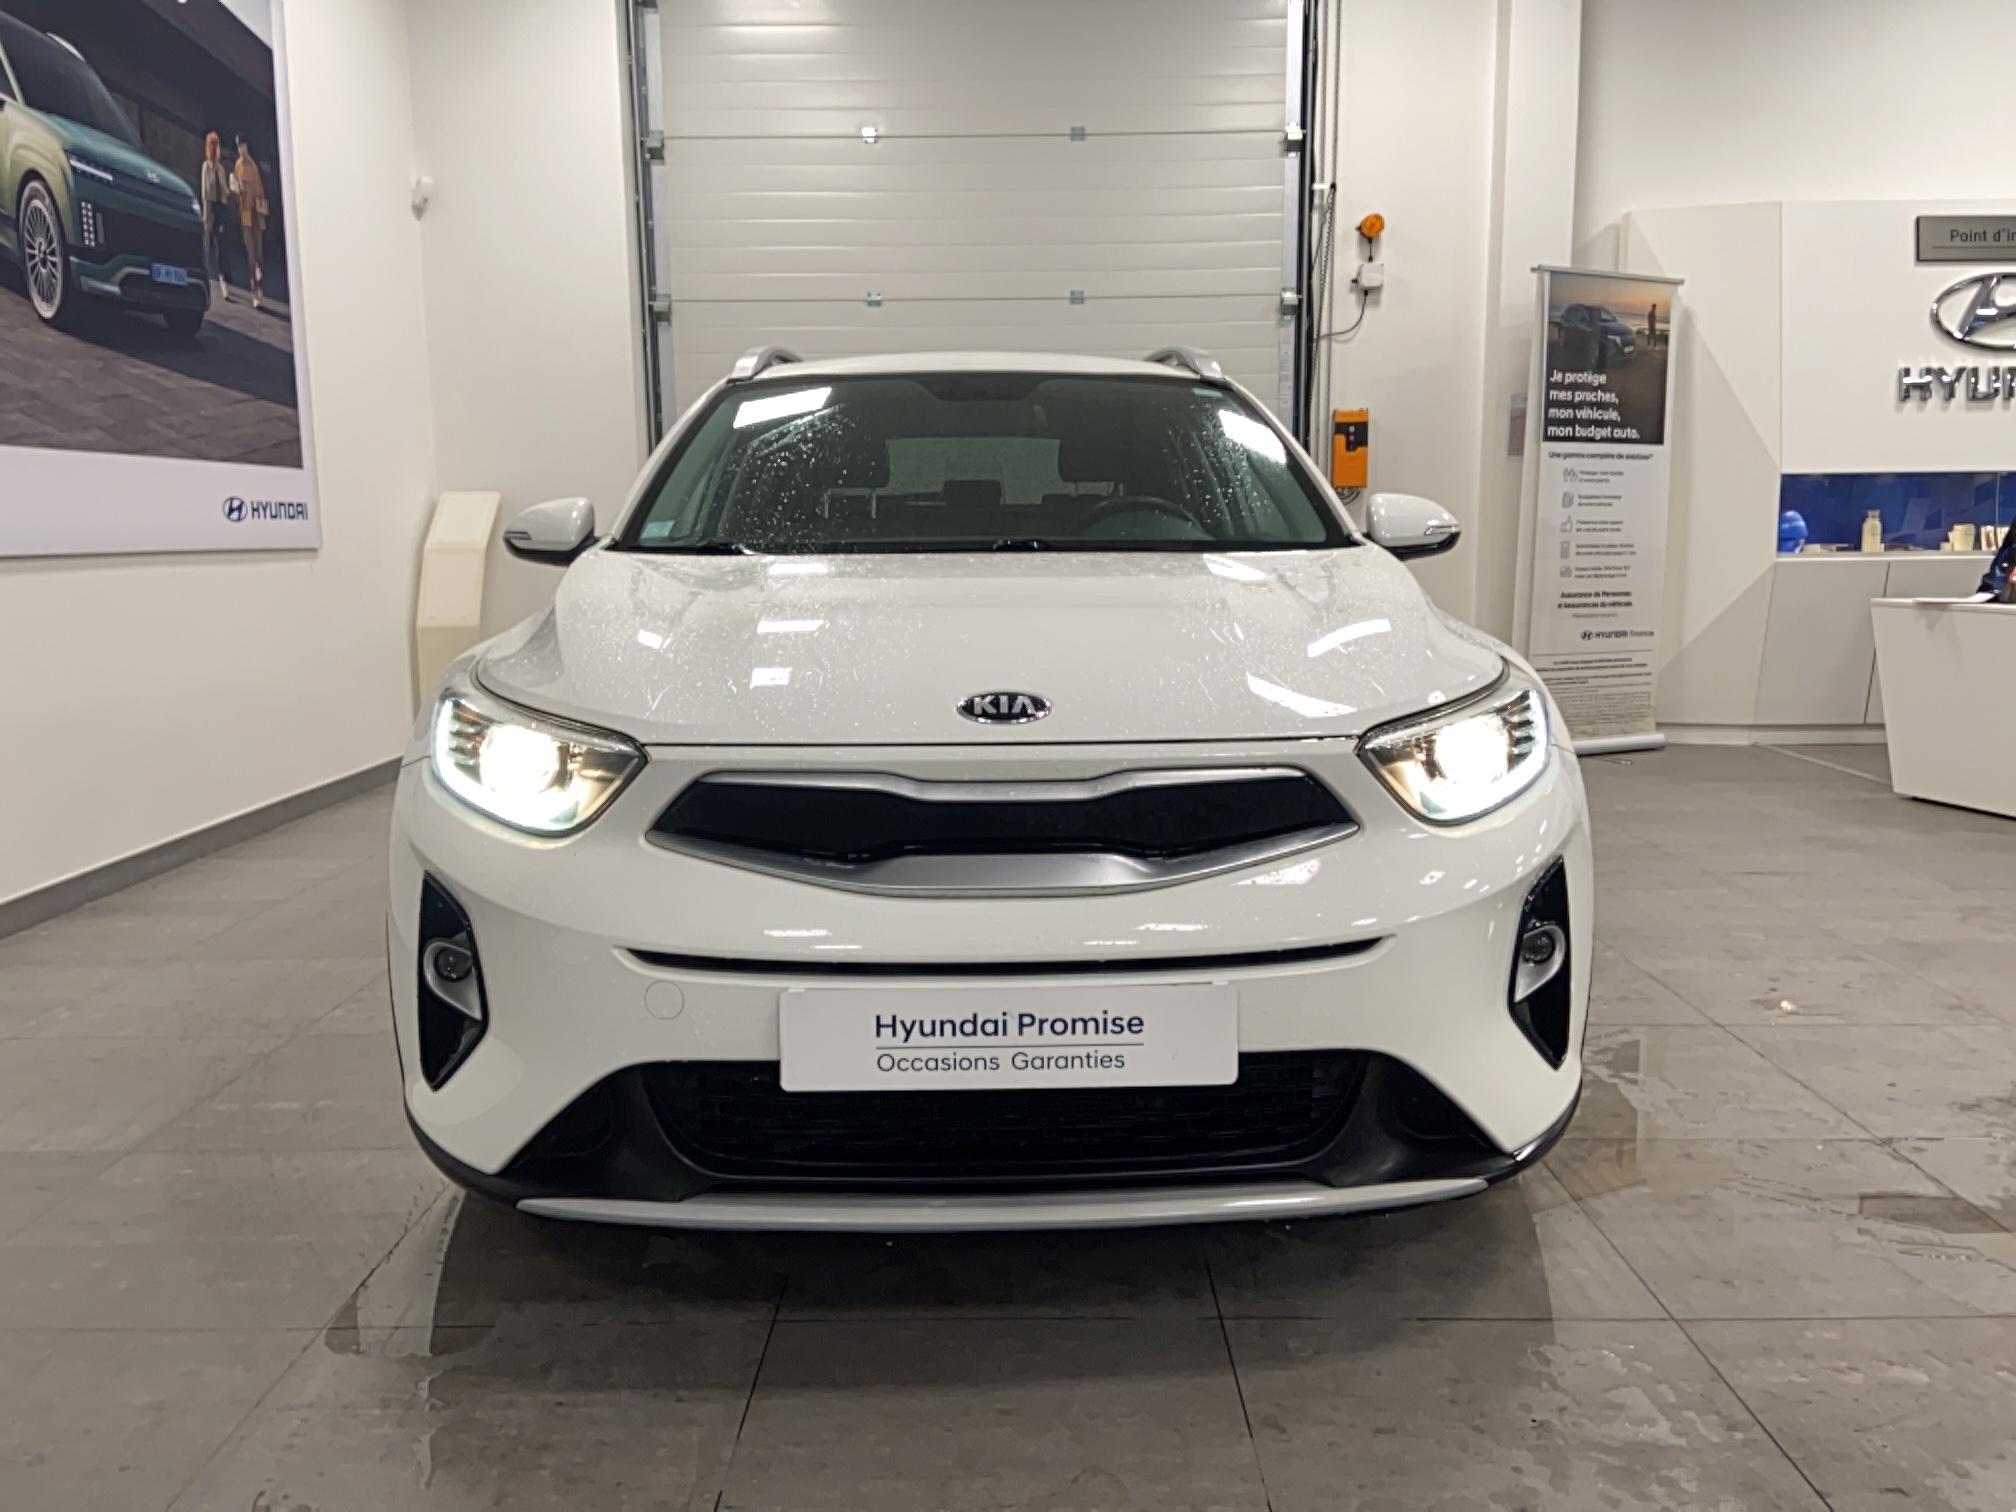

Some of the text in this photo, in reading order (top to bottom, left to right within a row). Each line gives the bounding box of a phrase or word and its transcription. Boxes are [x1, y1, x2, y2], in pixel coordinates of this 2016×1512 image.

[1950, 229, 1987, 242] Point
[1550, 369, 1607, 386] Je protège
[1550, 389, 1618, 405] mes proches,
[1548, 407, 1620, 422] mon véhicule,
[1547, 424, 1640, 440] mon budget auto.
[250, 501, 308, 520] HYUNDAI
[973, 695, 1037, 715] KIA
[875, 1010, 1145, 1043] Hyundai Promise
[877, 1050, 1125, 1072] Occasions Garanties
